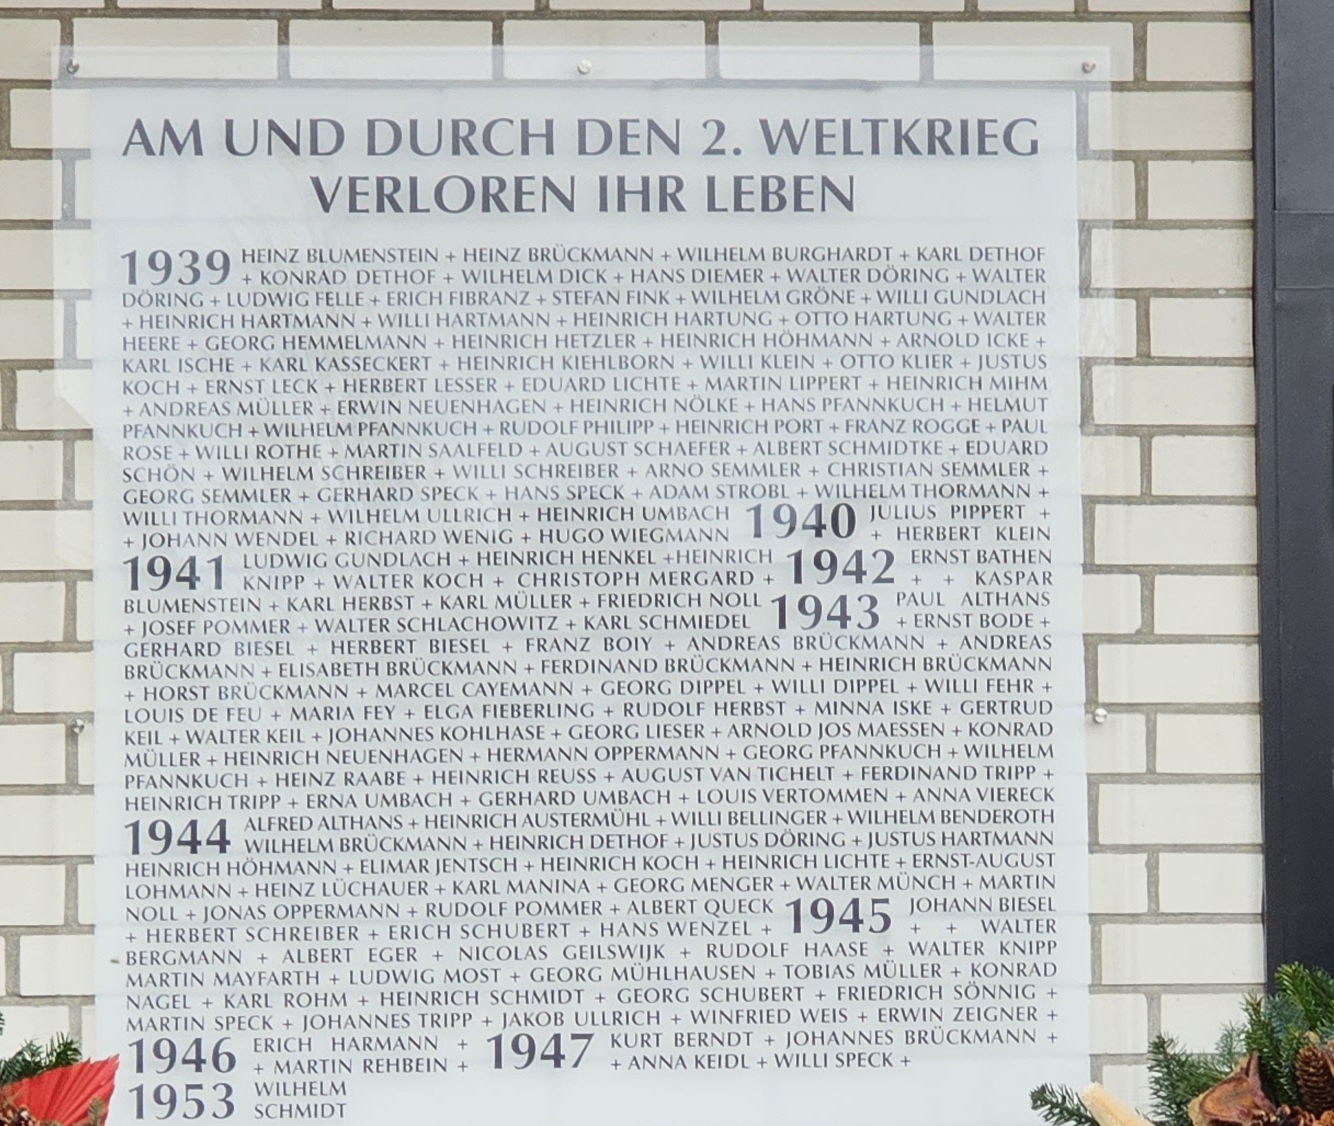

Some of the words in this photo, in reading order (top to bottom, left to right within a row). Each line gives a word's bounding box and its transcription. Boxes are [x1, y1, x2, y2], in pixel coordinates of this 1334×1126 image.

[122, 118, 203, 156] AM
[225, 119, 345, 156] UND
[367, 118, 554, 156] DURCH
[578, 119, 680, 155] DEN
[702, 119, 741, 156] 2.
[759, 118, 1038, 156] WELTKRIEG
[310, 175, 574, 214] VERLOREN
[599, 175, 686, 212] IHR
[707, 175, 853, 212] LEBEN
[241, 249, 299, 263] HEINZ
[307, 248, 438, 263] BLUMENSTEIN
[463, 248, 520, 262] HEINZ
[528, 242, 653, 262] BRÜCKMANN
[676, 247, 765, 262] WILHELM
[772, 247, 893, 262] BURGHARDT
[917, 247, 962, 261] KARL
[969, 247, 1045, 262] DETHOF
[121, 250, 230, 285] 1939
[123, 380, 179, 395] KOCH
[205, 379, 265, 394] ERNST
[272, 379, 318, 394] LECK
[343, 378, 427, 393] HERBERT
[435, 378, 497, 392] LESSER
[522, 377, 605, 392] EDUARD
[613, 377, 679, 391] LICHTE
[705, 376, 781, 391] MARTIN
[789, 376, 861, 390] LIPPERT
[887, 376, 982, 390] HEINRICH
[989, 376, 1047, 390] MIHM
[746, 503, 856, 538] 1940
[123, 555, 222, 591] 1941
[787, 549, 894, 585] 1942
[771, 594, 879, 630] 1943
[123, 642, 221, 658] GERHARD
[234, 641, 294, 656] BIESEL
[331, 639, 417, 655] HERBERT
[429, 638, 489, 654] BIESEL
[525, 637, 591, 652] FRANZ
[603, 637, 652, 652] BOIY
[687, 636, 780, 651] ANDREAS
[793, 630, 924, 650] BRÜCKMANN
[959, 635, 1052, 650] ANDREAS
[124, 708, 184, 723] LOUIS
[193, 708, 217, 722] DE
[226, 707, 261, 722] FEU
[289, 706, 355, 721] MARIA
[363, 705, 395, 720] FEY
[424, 704, 473, 719] ELGA
[482, 703, 594, 718] FIEBERLING
[623, 701, 705, 717] RUDOLF
[714, 701, 786, 716] HERBST
[814, 701, 884, 715] MINNA
[893, 700, 931, 716] ISKE
[959, 700, 1053, 715] GERTRUD
[125, 773, 247, 789] PFANNKUCH
[275, 772, 335, 787] HEINZ
[343, 771, 405, 786] RAABE
[432, 769, 529, 785] HEINRICH
[537, 768, 596, 784] REUSS
[621, 767, 701, 783] AUGUST
[709, 767, 751, 782] VAN
[759, 766, 832, 782] TICHELT
[861, 766, 977, 781] FERDINAND
[983, 765, 1036, 780] TRIPP
[124, 819, 231, 855] 1944
[243, 838, 334, 854] WILHELM
[339, 832, 466, 852] BRÜCKMANN
[489, 834, 583, 850] HEINRICH
[590, 834, 668, 849] DETHOF
[690, 834, 759, 850] JUSTUS
[764, 827, 845, 847] DÖRING
[867, 833, 936, 849] JUSTUS
[941, 831, 1053, 846] HARTMANN
[786, 898, 891, 934] 1945
[125, 972, 204, 987] MARTIN
[213, 971, 319, 986] MAYFARTH
[349, 969, 434, 985] LUDWIG
[443, 968, 501, 983] MOST
[529, 967, 601, 982] GEORG
[610, 961, 755, 981] MÜHLHAUSEN
[782, 964, 855, 979] TOBIAS
[863, 958, 941, 978] MÜLLER
[970, 962, 1057, 978] KONRAD
[253, 1037, 311, 1052] ERICH
[331, 1036, 437, 1051] HARMANN
[610, 1033, 663, 1048] KURT
[674, 1032, 753, 1047] BERNDT
[786, 1030, 893, 1046] JOHANNES
[904, 1025, 1035, 1045] BRÜCKMANN
[128, 1037, 236, 1074] 1946
[273, 1059, 352, 1074] MARTIN
[363, 1058, 447, 1073] REHBEIN
[487, 1033, 595, 1070] 1947
[627, 1055, 687, 1070] ANNA
[694, 1054, 749, 1069] KEIDL
[773, 1053, 827, 1068] WILLI
[835, 1052, 893, 1068] SPECK
[129, 1083, 234, 1120] 1953
[254, 1081, 346, 1096] WILHELM
[254, 1103, 347, 1119] SCHMIDT
